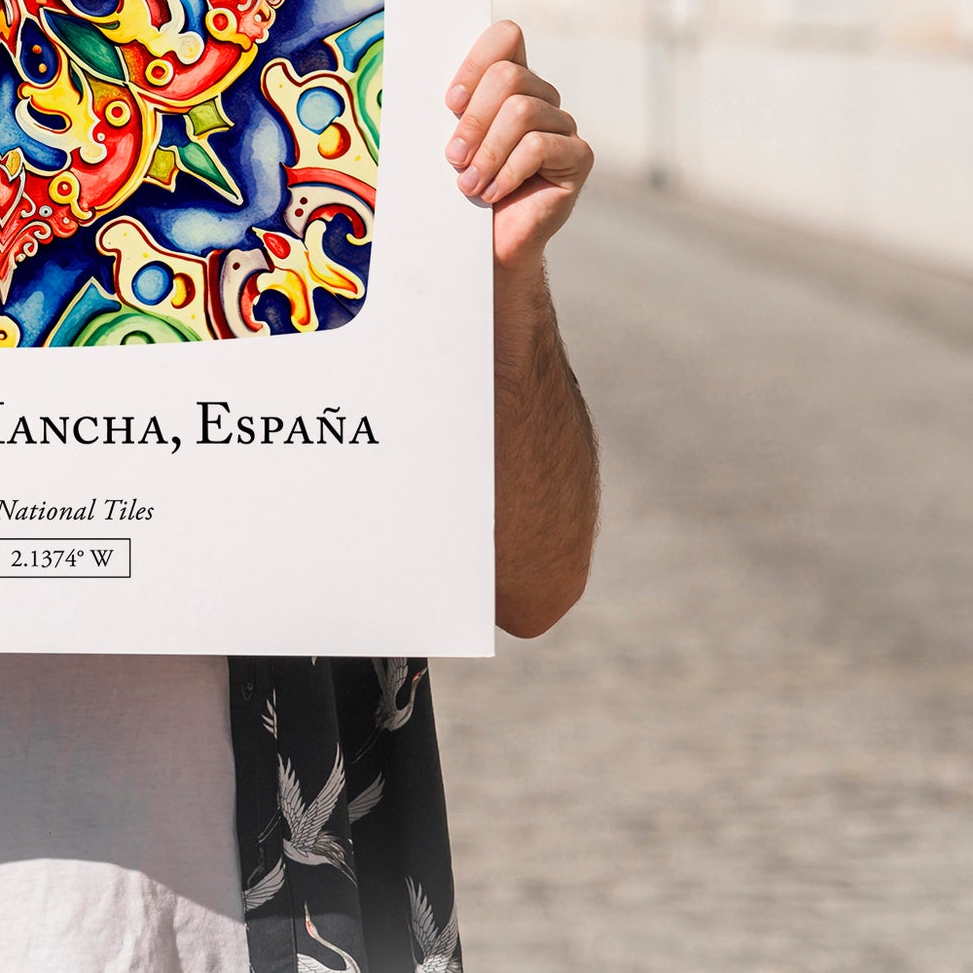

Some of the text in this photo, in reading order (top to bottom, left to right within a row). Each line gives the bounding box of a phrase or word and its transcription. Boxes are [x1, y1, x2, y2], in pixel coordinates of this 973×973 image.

[104, 498, 155, 521] Tiles
[10, 548, 85, 568] 2.1374°
[89, 549, 115, 567] W
